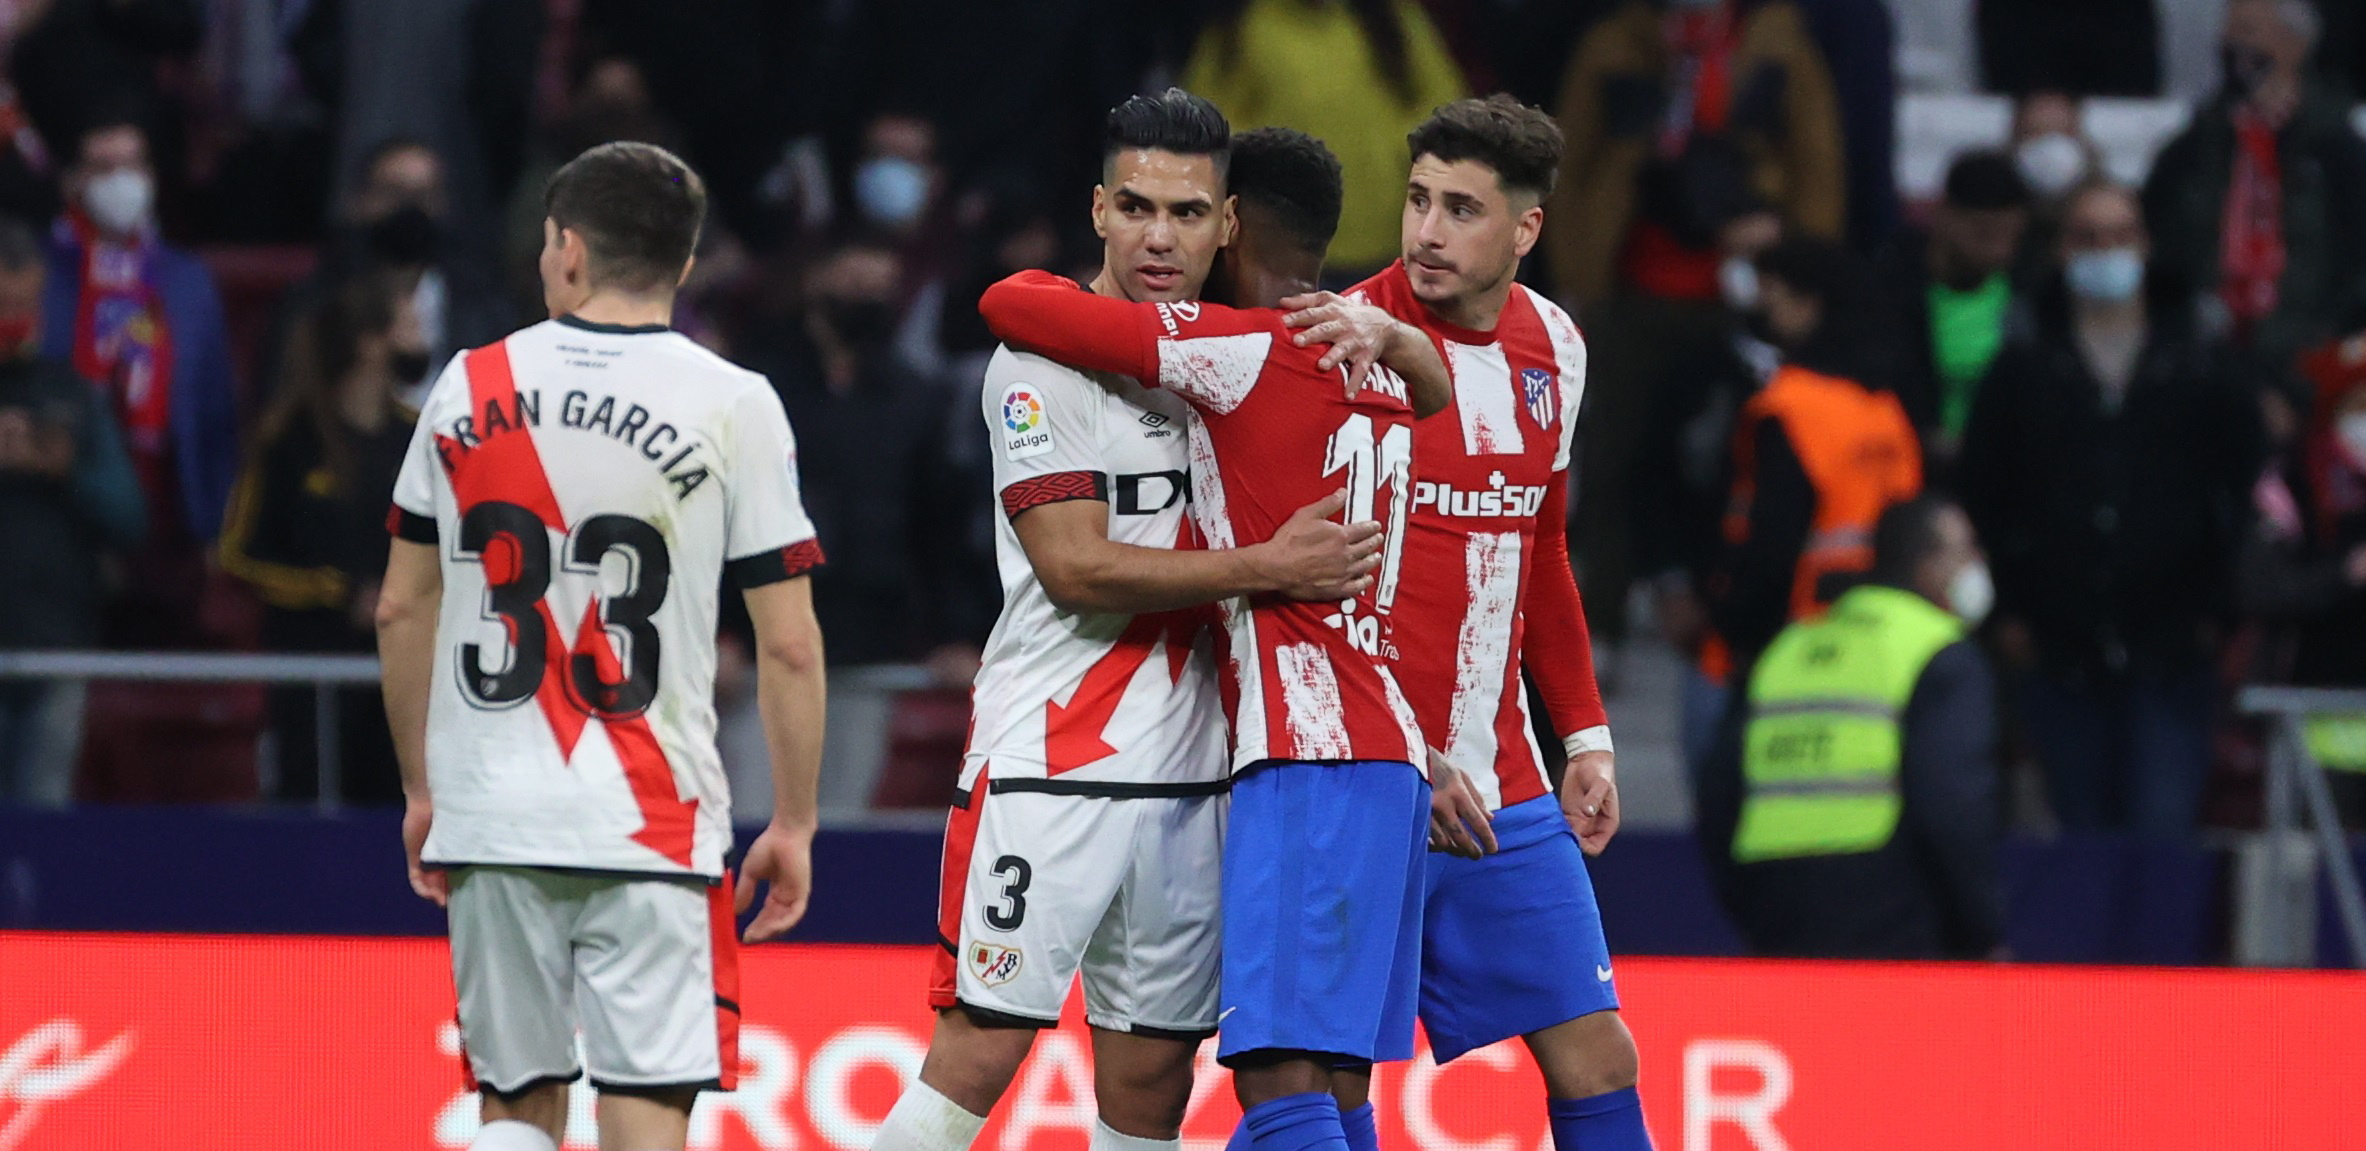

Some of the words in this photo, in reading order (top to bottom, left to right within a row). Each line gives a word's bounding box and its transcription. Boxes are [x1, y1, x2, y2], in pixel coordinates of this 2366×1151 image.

[434, 389, 541, 473] FRAN
[560, 389, 709, 501] GARCÍA
[1008, 433, 1049, 451] LaLiga
[1143, 428, 1171, 439] umbro
[1322, 412, 1411, 615] 11
[450, 501, 671, 722] 33
[982, 854, 1032, 933] 3
